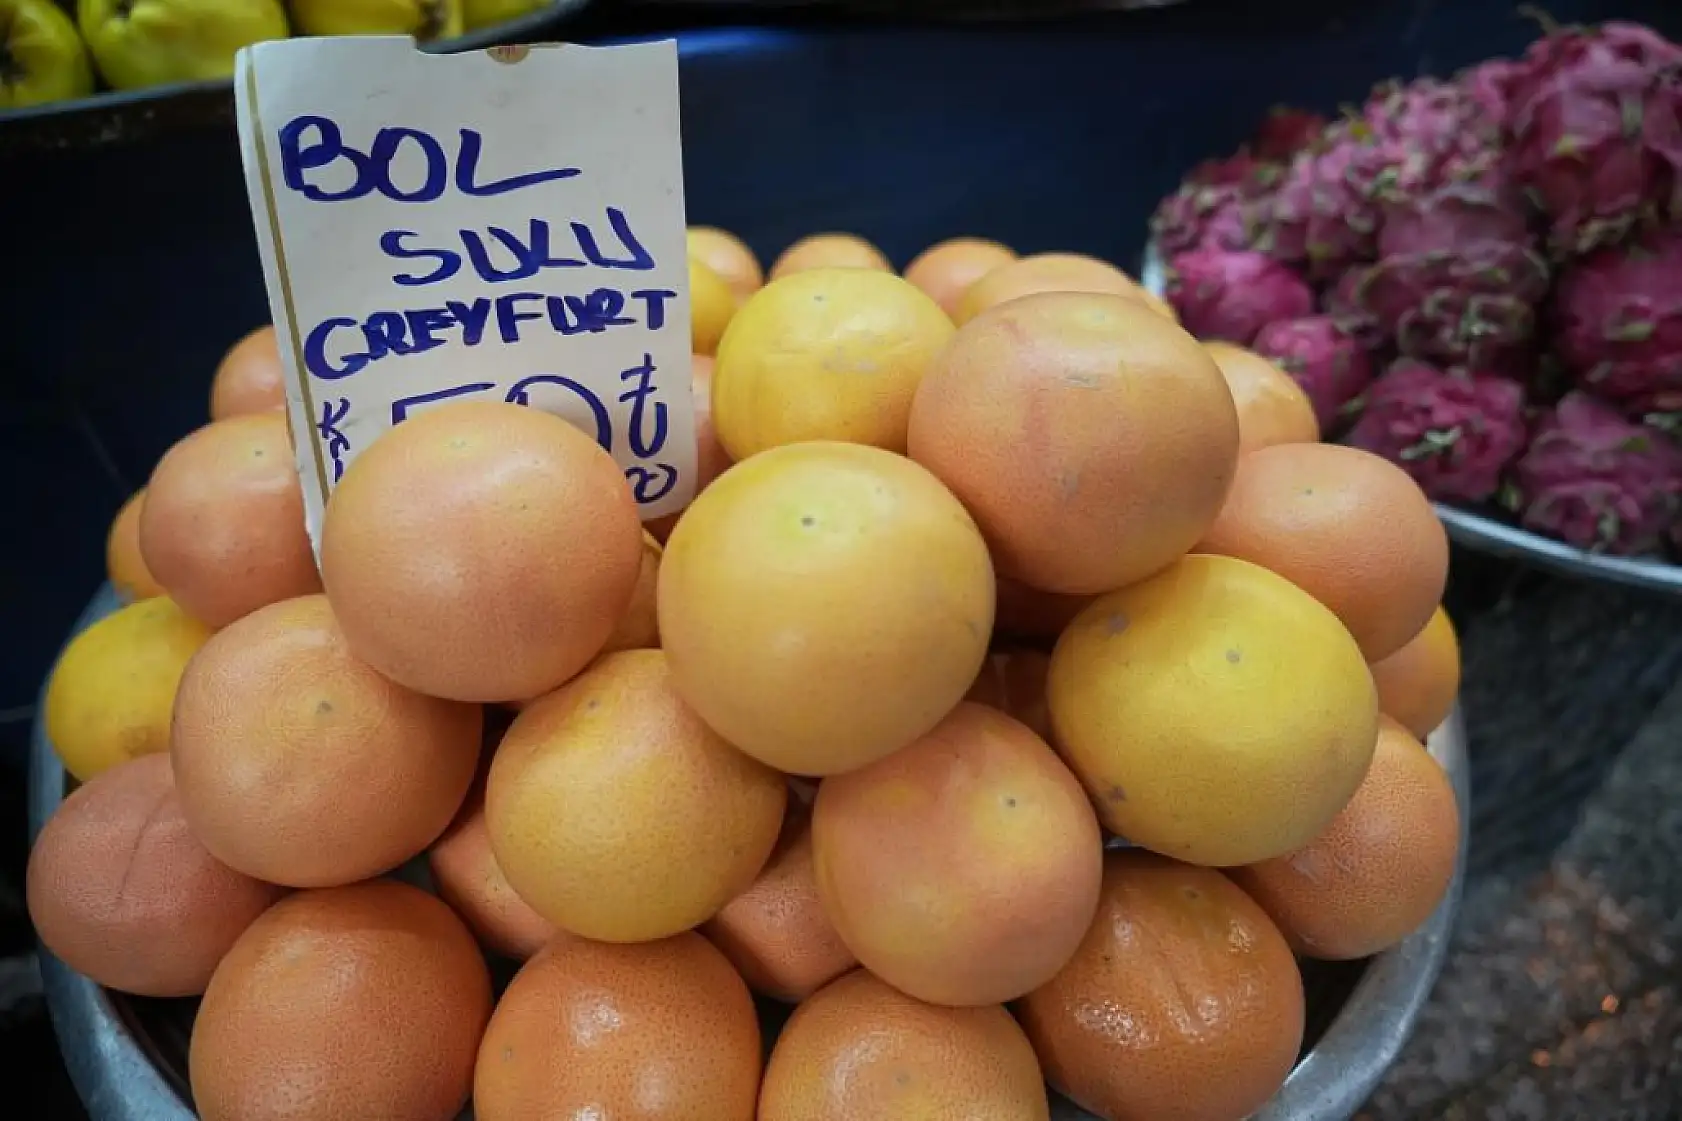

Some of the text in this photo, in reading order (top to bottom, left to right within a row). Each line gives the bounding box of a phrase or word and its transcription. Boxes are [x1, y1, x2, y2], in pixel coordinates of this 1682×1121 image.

[279, 115, 582, 202] BOL
[380, 207, 655, 286] SULU
[304, 288, 678, 380] GREYFURT
